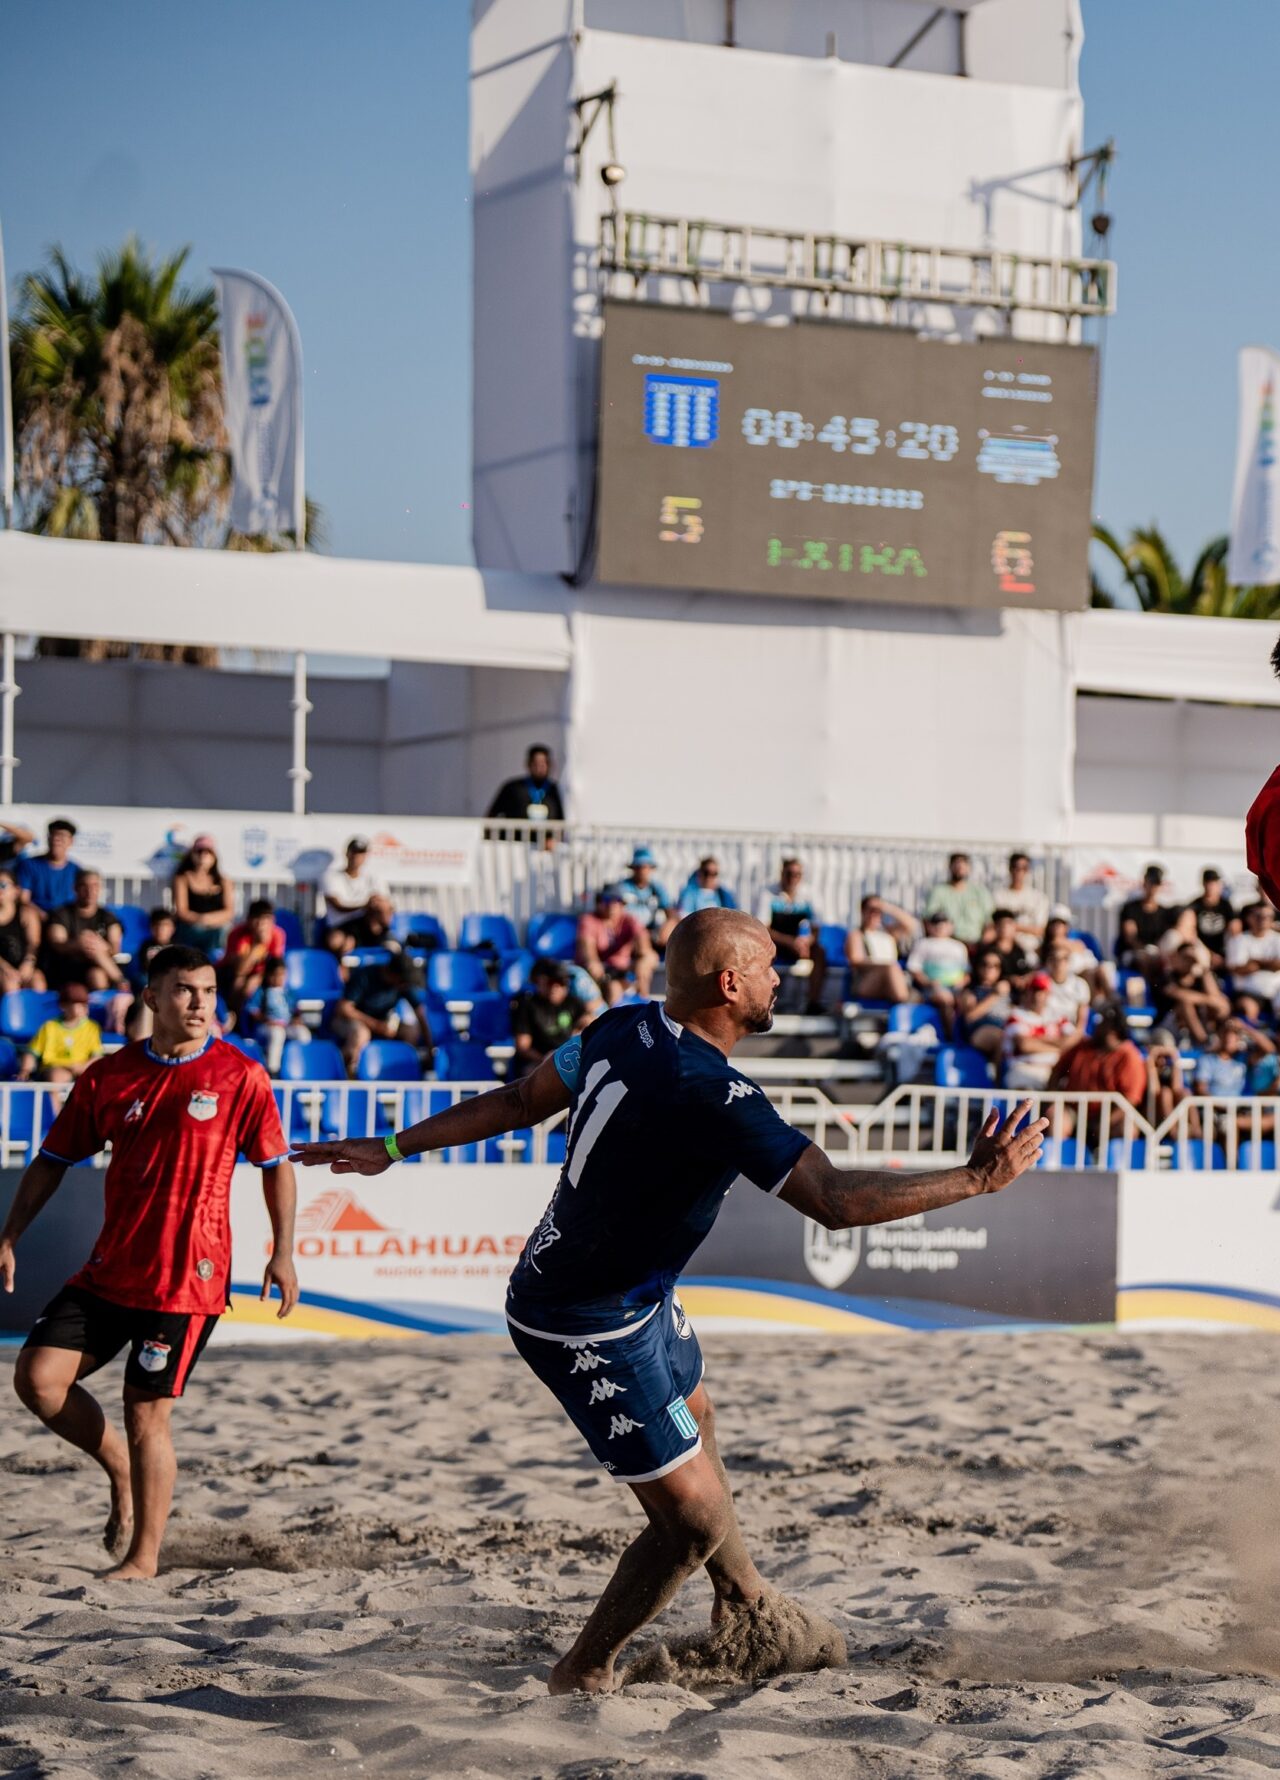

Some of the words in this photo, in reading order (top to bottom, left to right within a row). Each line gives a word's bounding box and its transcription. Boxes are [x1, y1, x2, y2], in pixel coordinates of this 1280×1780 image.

[741, 408, 959, 462] 00:45:20
[660, 496, 704, 543] 5
[991, 530, 1034, 577] 6
[637, 1020, 655, 1049] Kappa
[567, 1058, 629, 1190] 11
[264, 1234, 527, 1258] OLLAHUAS
[866, 1226, 988, 1250] Municipalidad
[866, 1248, 892, 1269] de
[893, 1247, 959, 1273] Iquique
